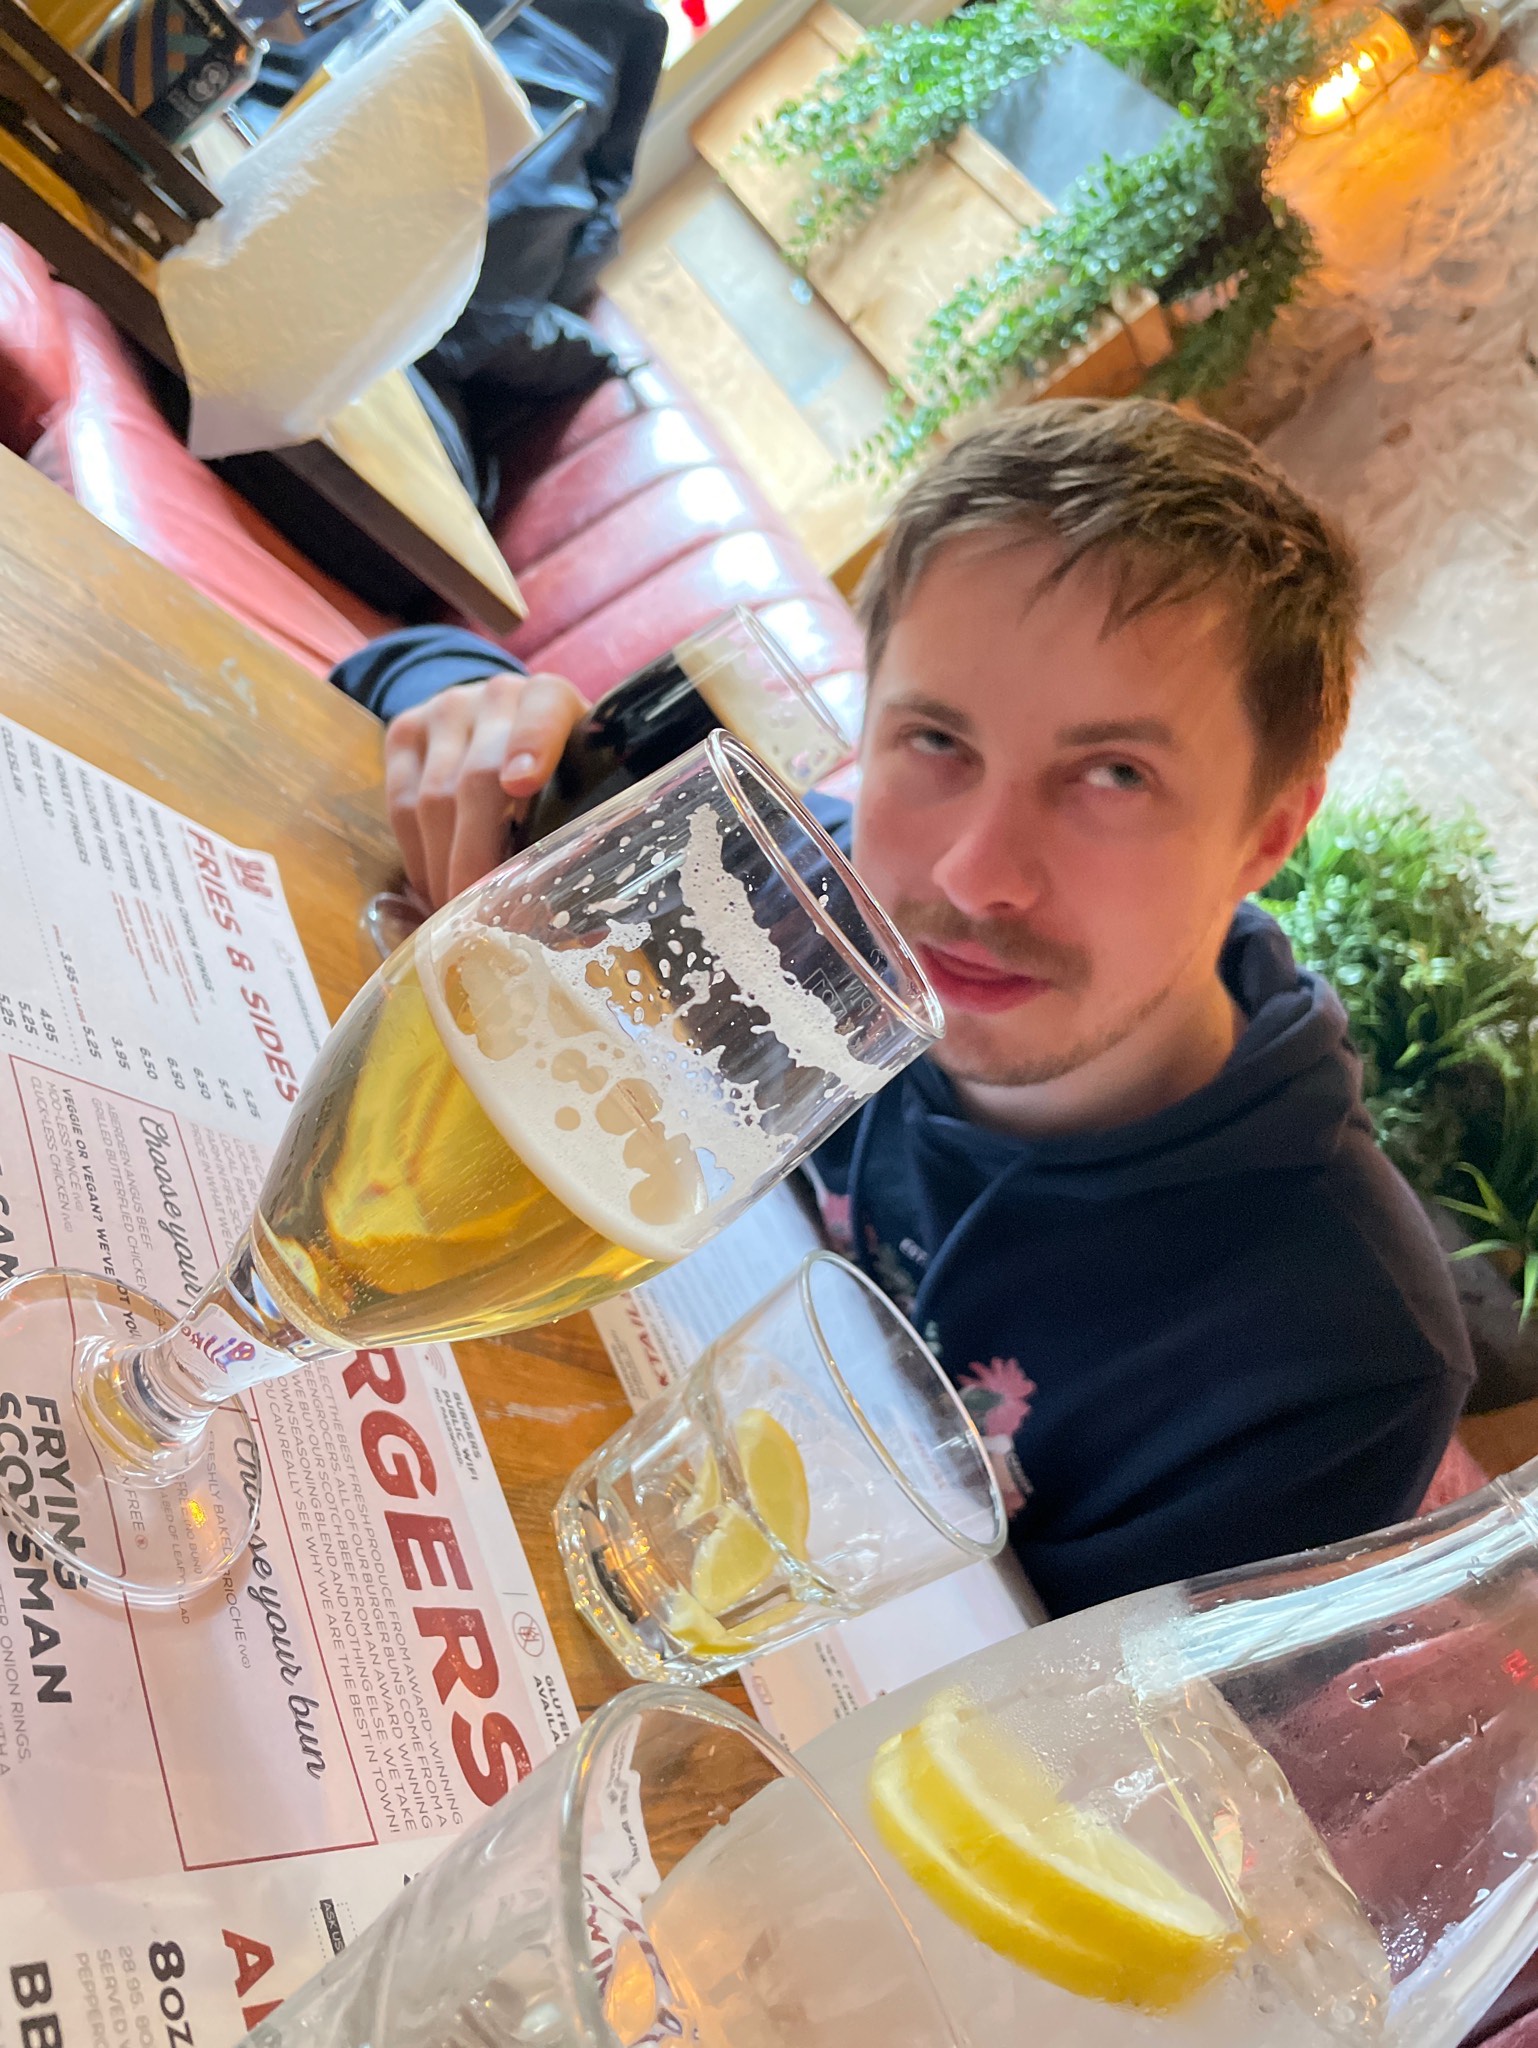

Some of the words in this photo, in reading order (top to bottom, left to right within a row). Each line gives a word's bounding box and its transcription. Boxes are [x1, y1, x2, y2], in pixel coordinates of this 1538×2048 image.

[0, 725, 26, 797] COLESLAW
[26, 739, 44, 774] SIDE
[33, 771, 55, 818] SALAD
[52, 753, 75, 810] MONKEY
[66, 809, 91, 866] FINGERS
[77, 767, 104, 835] HALLOUMI
[95, 834, 115, 873] FRIES
[101, 780, 124, 829] HAGGIS
[115, 829, 141, 891] FRITTERS
[139, 843, 162, 893] CHEESE
[157, 840, 185, 905] BATTERED
[178, 906, 200, 950] ONION
[193, 951, 215, 992] RINGS
[188, 827, 242, 936] FRIES
[225, 946, 255, 972] &
[240, 986, 299, 1103] SIDES
[0, 994, 17, 1028] 5.25
[17, 1000, 39, 1036] 5.25
[39, 1008, 59, 1044] 4.95
[59, 950, 80, 987] 3.95
[82, 1025, 102, 1060] 5.25
[111, 1036, 131, 1071] 3.95
[139, 1046, 159, 1080] 6.50
[166, 1057, 186, 1091] 6.50
[192, 1067, 212, 1100] 6.50
[218, 1078, 237, 1110] 5.45
[242, 1088, 262, 1119] 5.25
[62, 1088, 83, 1136] VEGGIE
[30, 1075, 59, 1151] CLUCK-LESS
[49, 1153, 71, 1212] CHICKEN
[39, 1081, 73, 1148] MOO-LESS
[63, 1148, 83, 1194] MINCE
[75, 1139, 89, 1160] OR
[189, 1122, 209, 1162] PRIDE
[204, 1127, 223, 1164] FARM
[215, 1160, 227, 1178] IN
[218, 1132, 239, 1174] LOCAL
[232, 1137, 253, 1177] LOCAL
[106, 1101, 133, 1173] ABERDEEN
[124, 1169, 145, 1214] ANGUS
[135, 1215, 154, 1251] BEEF
[138, 1116, 183, 1220] Choose
[201, 1159, 213, 1175] IN
[81, 1165, 104, 1223] VEGAN?
[91, 1097, 114, 1148] GRILLED
[105, 1143, 140, 1234] BUTTERFLIED
[125, 1232, 148, 1291] CHICKEN
[205, 1175, 226, 1216] WHAT
[217, 1216, 233, 1242] WE
[96, 1228, 116, 1280] WE'VE
[158, 1210, 203, 1300] your
[291, 1374, 308, 1405] WE
[433, 1387, 443, 1404] NO
[269, 1402, 287, 1442] CAN
[298, 1401, 316, 1433] BUY
[441, 1389, 466, 1442] PUBLIC
[462, 1448, 479, 1481] WIFI
[452, 1391, 482, 1459] BURGERS
[278, 1438, 304, 1504] REALLY
[308, 1433, 326, 1469] OUR
[26, 1395, 90, 1592] FRYING
[124, 1489, 146, 1535] FREE
[295, 1500, 313, 1532] SEE
[318, 1470, 345, 1537] SCOTCH
[334, 1477, 351, 1507] ALL
[167, 1524, 178, 1540] OF
[344, 1508, 359, 1531] OF
[305, 1536, 325, 1578] WHY
[337, 1539, 359, 1588] BEEF
[351, 1533, 372, 1577] OUR
[212, 1504, 233, 1559] BAKED
[237, 1644, 252, 1669] (VG)
[276, 1375, 297, 1420] OWN
[287, 1415, 322, 1510] SEASONING
[314, 1511, 338, 1568] BLEND
[329, 1563, 349, 1608] AND
[341, 1610, 373, 1692] NOTHING
[383, 1747, 401, 1780] WE
[394, 1782, 418, 1831] TAKE
[312, 1359, 336, 1404] ELECT
[327, 1402, 345, 1432] THE
[336, 1433, 357, 1473] BEST
[348, 1473, 372, 1525] FRESH
[367, 1537, 396, 1609] PRODUCE
[388, 1611, 412, 1661] FROM
[403, 1663, 464, 1825] AWARD-WINNING
[317, 1580, 334, 1610] WE
[350, 1585, 373, 1636] FROM
[361, 1572, 391, 1643] BURGER
[325, 1613, 345, 1649] ARE
[365, 1639, 382, 1665] AN
[0, 1635, 21, 1696] ONION
[246, 1585, 303, 1686] your
[287, 1694, 326, 1780] bun
[337, 1653, 357, 1689] THE
[383, 1646, 406, 1696] BUNS
[348, 1694, 373, 1741] BEST
[373, 1669, 403, 1740] AWARD
[399, 1698, 425, 1752] COME
[533, 1675, 562, 1748] AVAILA
[364, 1745, 379, 1763] IN
[372, 1766, 401, 1833] TOWN!
[397, 1742, 433, 1829] WINNING
[416, 1755, 444, 1810] FROM
[435, 1814, 448, 1828] A
[323, 1900, 337, 1929] ASK
[331, 1929, 345, 1952] US
[96, 1948, 128, 2035] SERVED
